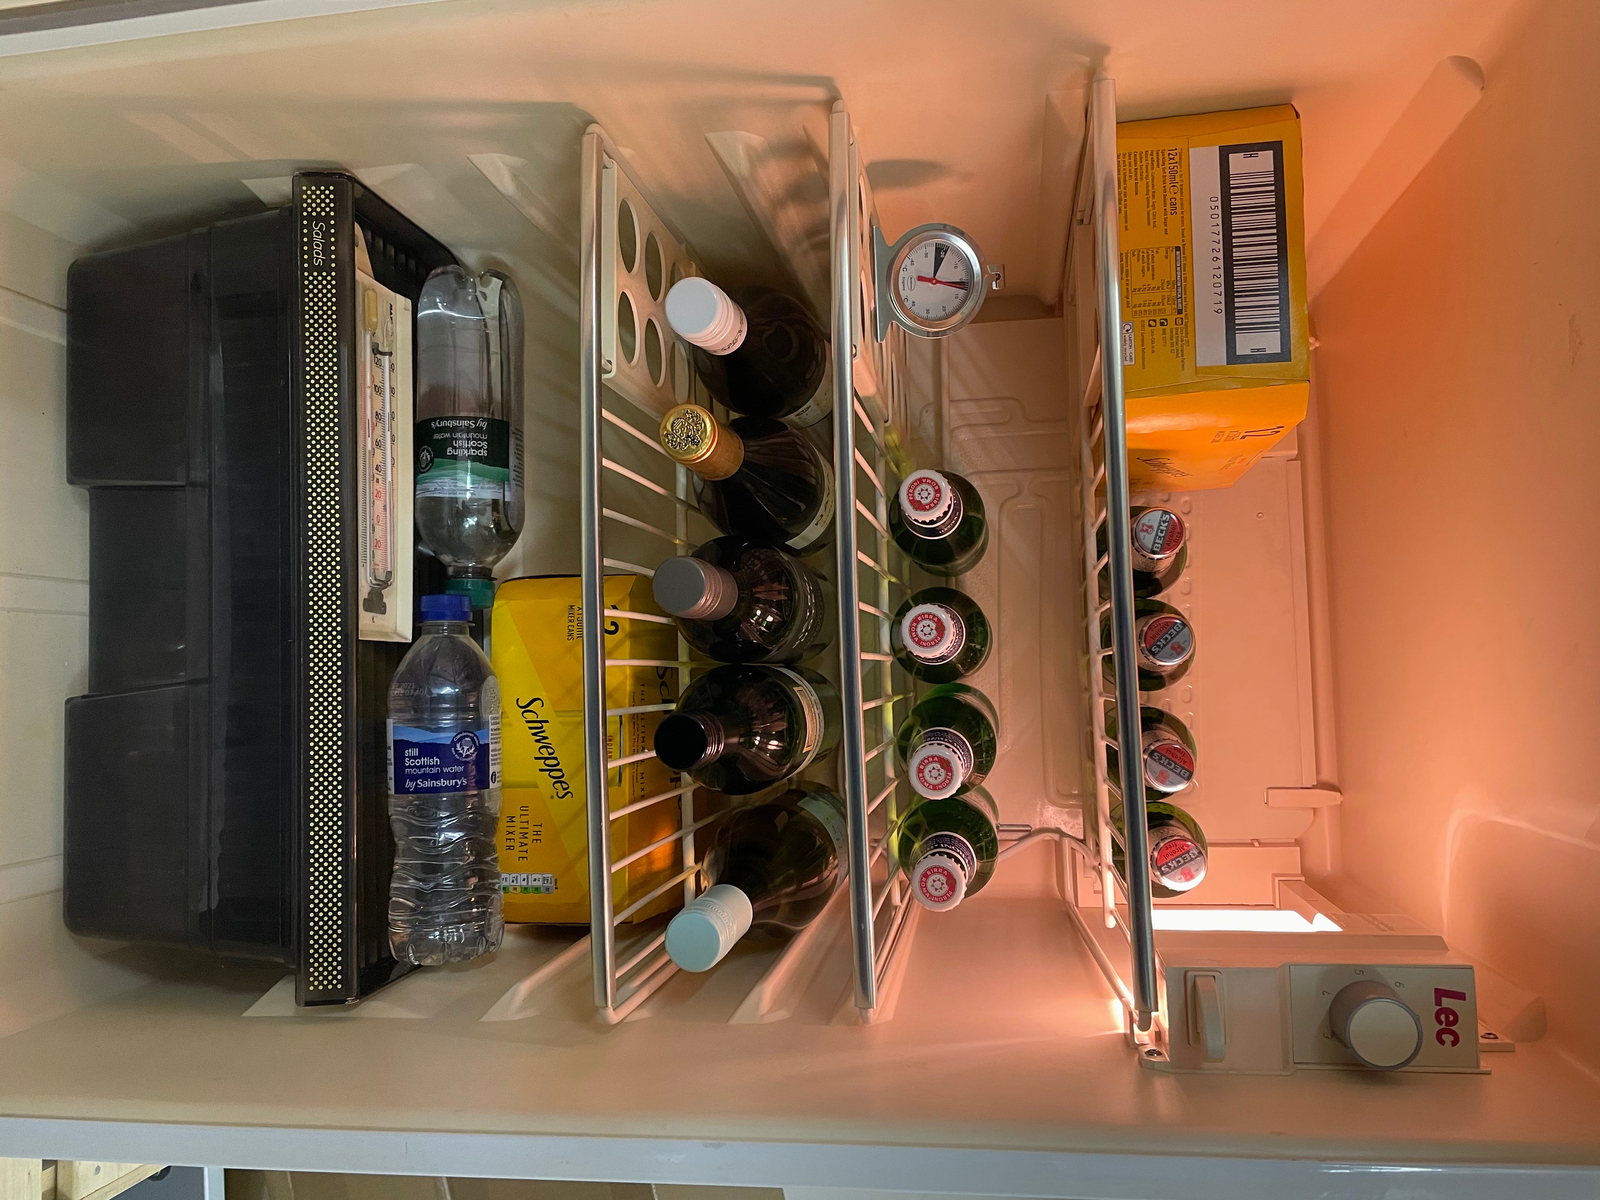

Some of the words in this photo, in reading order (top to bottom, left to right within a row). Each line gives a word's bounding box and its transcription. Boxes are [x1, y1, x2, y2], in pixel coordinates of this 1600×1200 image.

[1170, 197, 1178, 216] cans
[312, 221, 326, 266] Salads
[430, 420, 476, 430] Sainsbury's
[476, 418, 488, 430] by
[433, 432, 451, 441] water
[452, 432, 488, 441] mountain
[452, 440, 488, 450] Scottish
[447, 448, 488, 458] sparkling
[1152, 514, 1170, 552] BECK'S
[568, 605, 576, 624] MIXER
[1152, 622, 1183, 653] BECK'S
[404, 748, 418, 757] still
[516, 697, 574, 800] Schweppes
[404, 756, 440, 766] Scottish
[404, 766, 440, 775] mountain
[443, 765, 465, 774] water
[1152, 752, 1190, 778] BECK'S
[405, 780, 416, 791] by
[416, 777, 468, 788] Sainsbury's
[506, 816, 517, 850] MIXER
[518, 806, 530, 861] ULTIMATE
[532, 823, 542, 844] THE
[1160, 848, 1200, 874] BECK'S
[1434, 988, 1466, 1048] Lec
